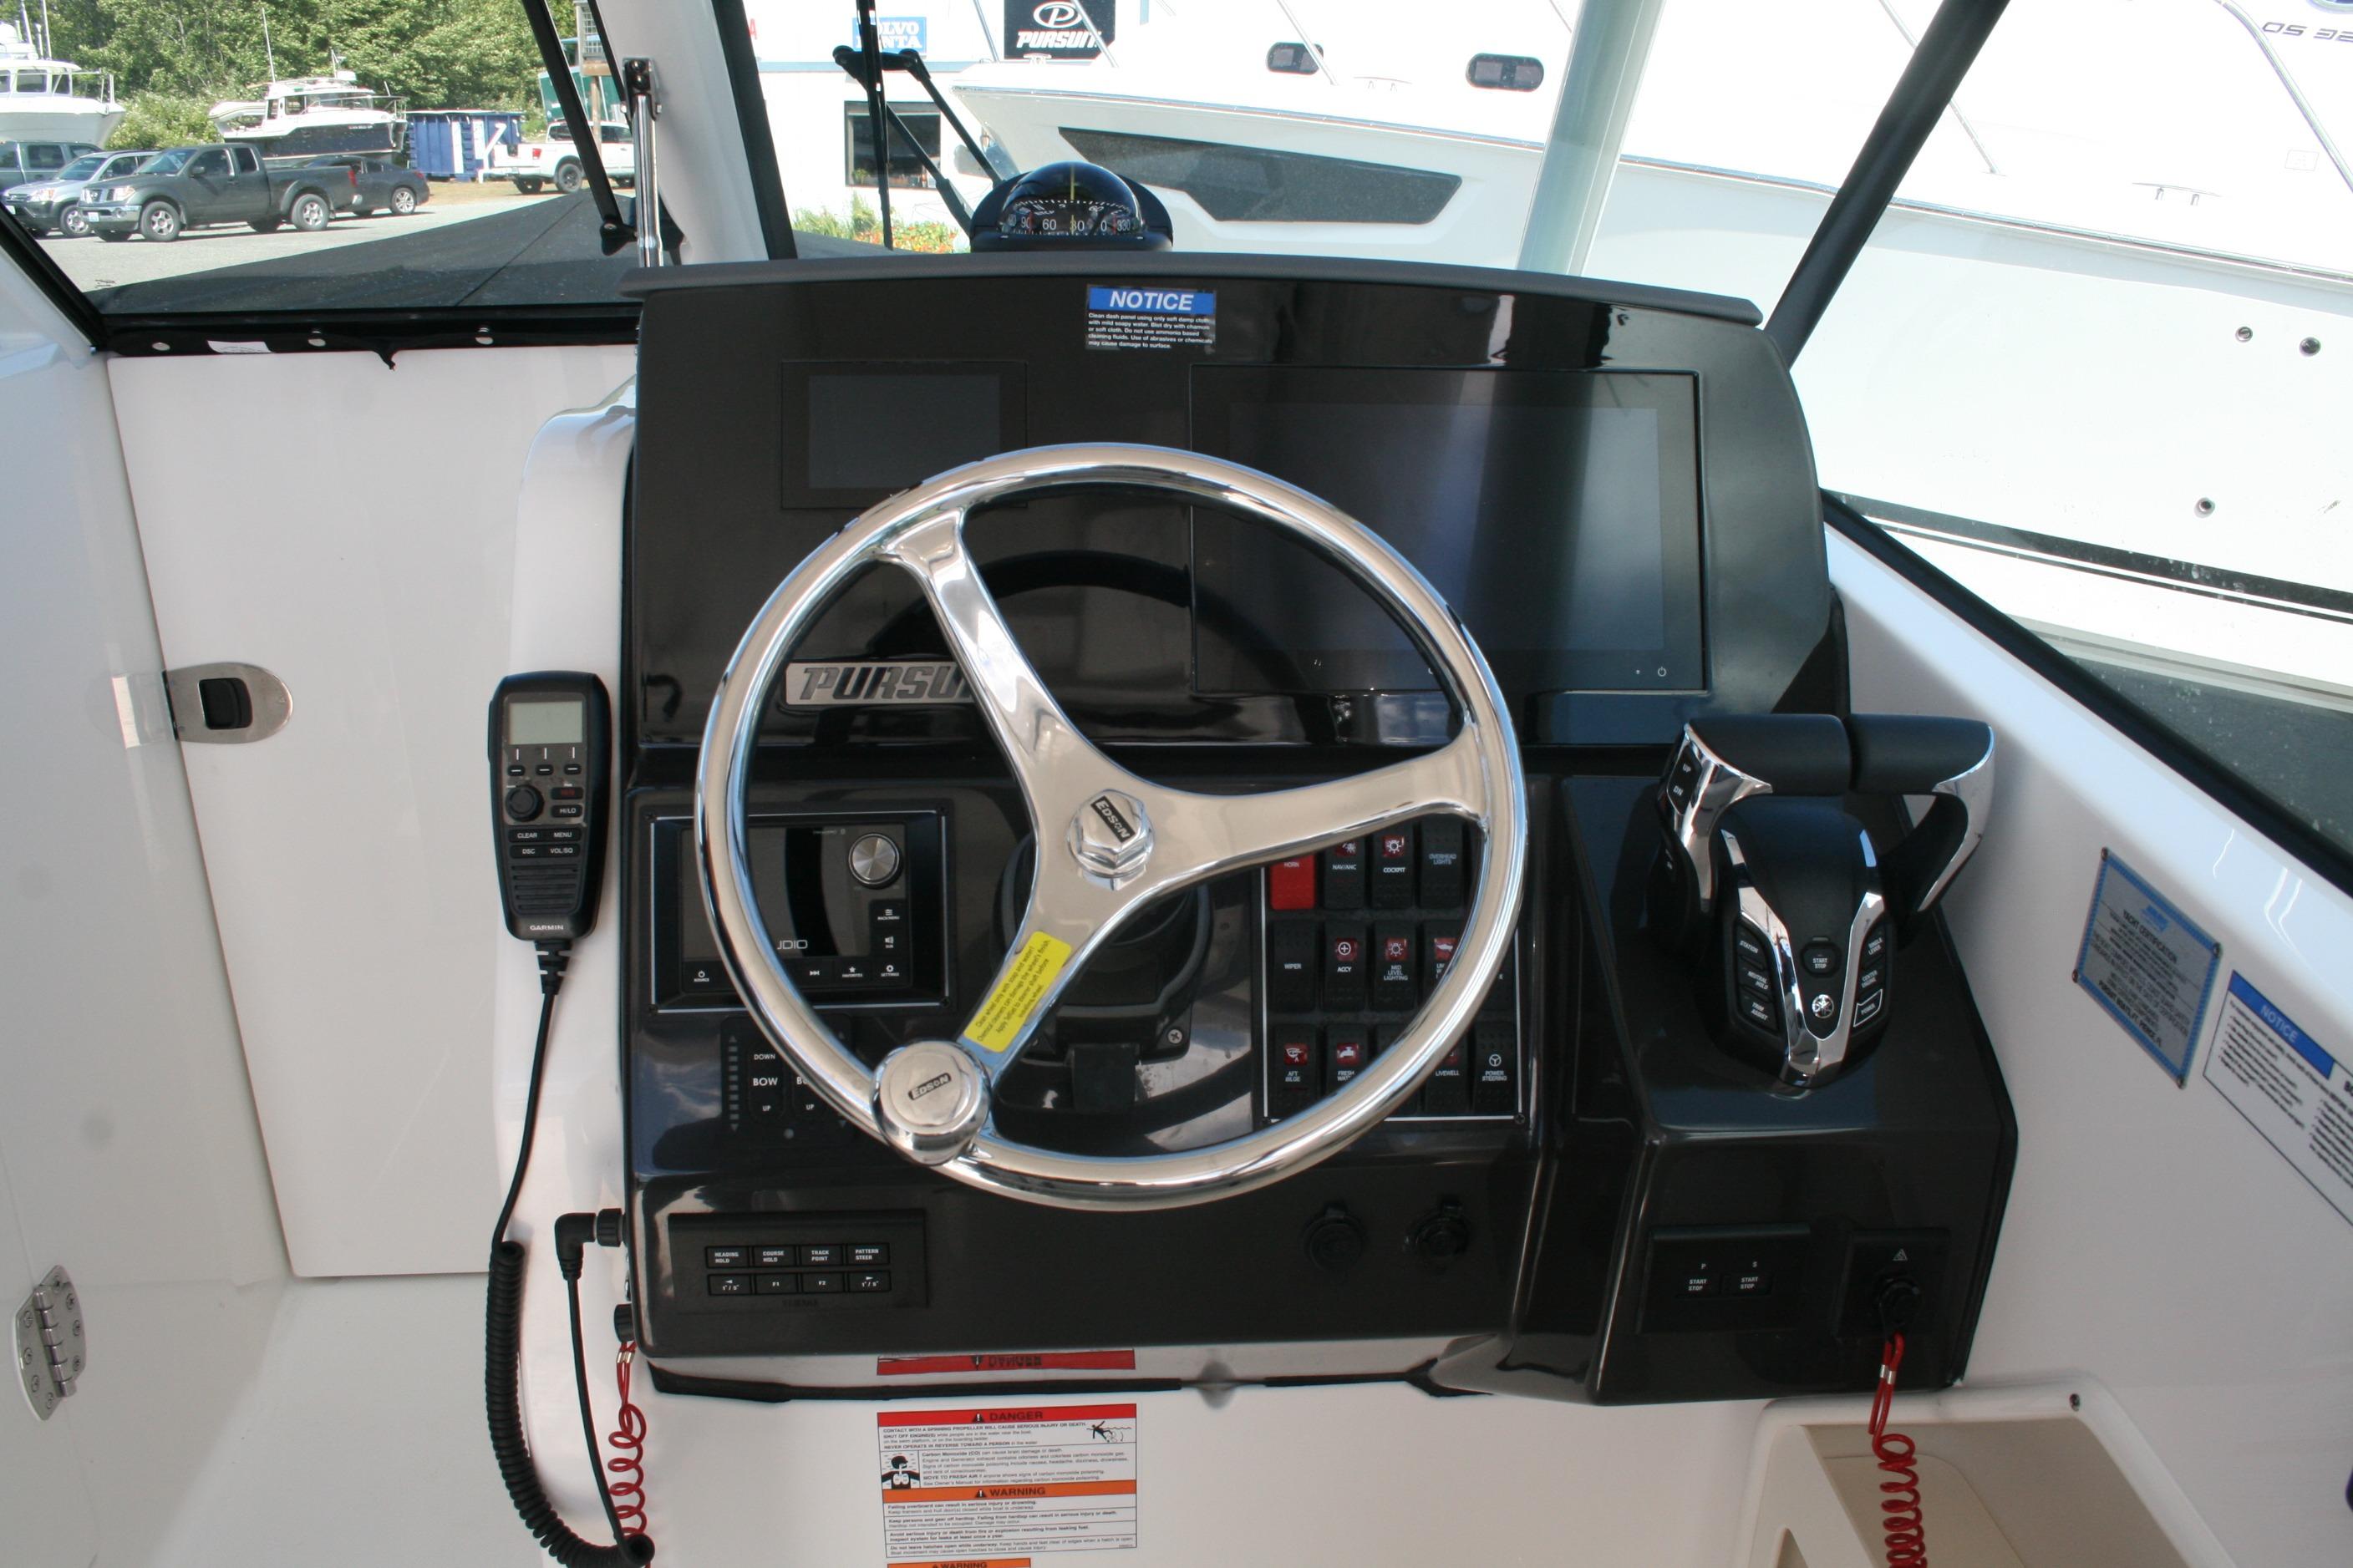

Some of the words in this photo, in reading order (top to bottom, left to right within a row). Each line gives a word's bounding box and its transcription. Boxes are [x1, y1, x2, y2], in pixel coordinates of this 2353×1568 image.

[2262, 22, 2308, 36] OS
[1042, 218, 1057, 231] 60
[1110, 291, 1194, 311] NOTICE
[800, 666, 973, 700] PURSU
[1095, 801, 1130, 838] EDSON
[2260, 1003, 2299, 1043] NOTICE
[753, 1077, 778, 1086] BOW
[989, 1411, 1043, 1421] DANGER
[989, 1487, 1045, 1496] WARNING
